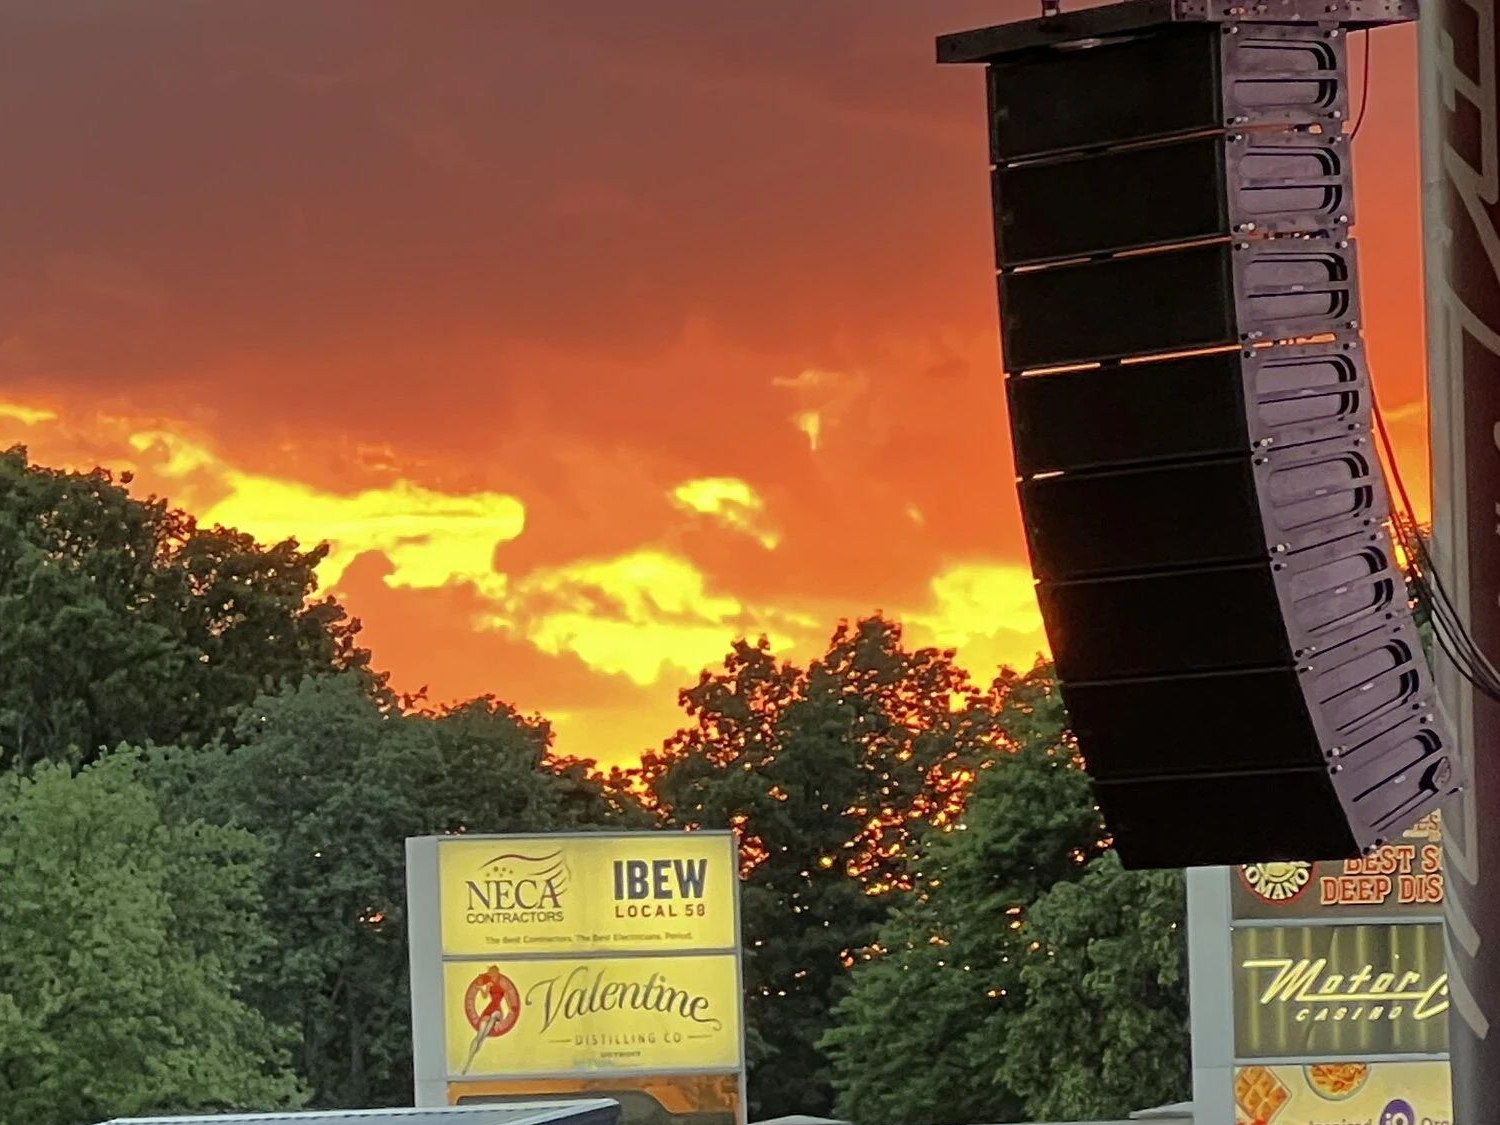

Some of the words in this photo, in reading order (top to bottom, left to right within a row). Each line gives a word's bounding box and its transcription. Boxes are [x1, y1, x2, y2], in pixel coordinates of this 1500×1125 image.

[1422, 846, 1443, 873] S
[613, 858, 708, 901] IBEW
[1243, 862, 1311, 899] OMANO
[1321, 876, 1391, 904] DEEP
[1399, 875, 1444, 902] DIS
[466, 878, 564, 911] NECA
[466, 911, 564, 924] CONTRACTORS
[615, 904, 678, 918] LOCAL
[685, 903, 707, 917] 58
[525, 966, 722, 1034] Valentine
[1295, 1006, 1406, 1022] CASINO
[575, 1032, 656, 1046] DISTILLING
[664, 1032, 682, 1043] CO
